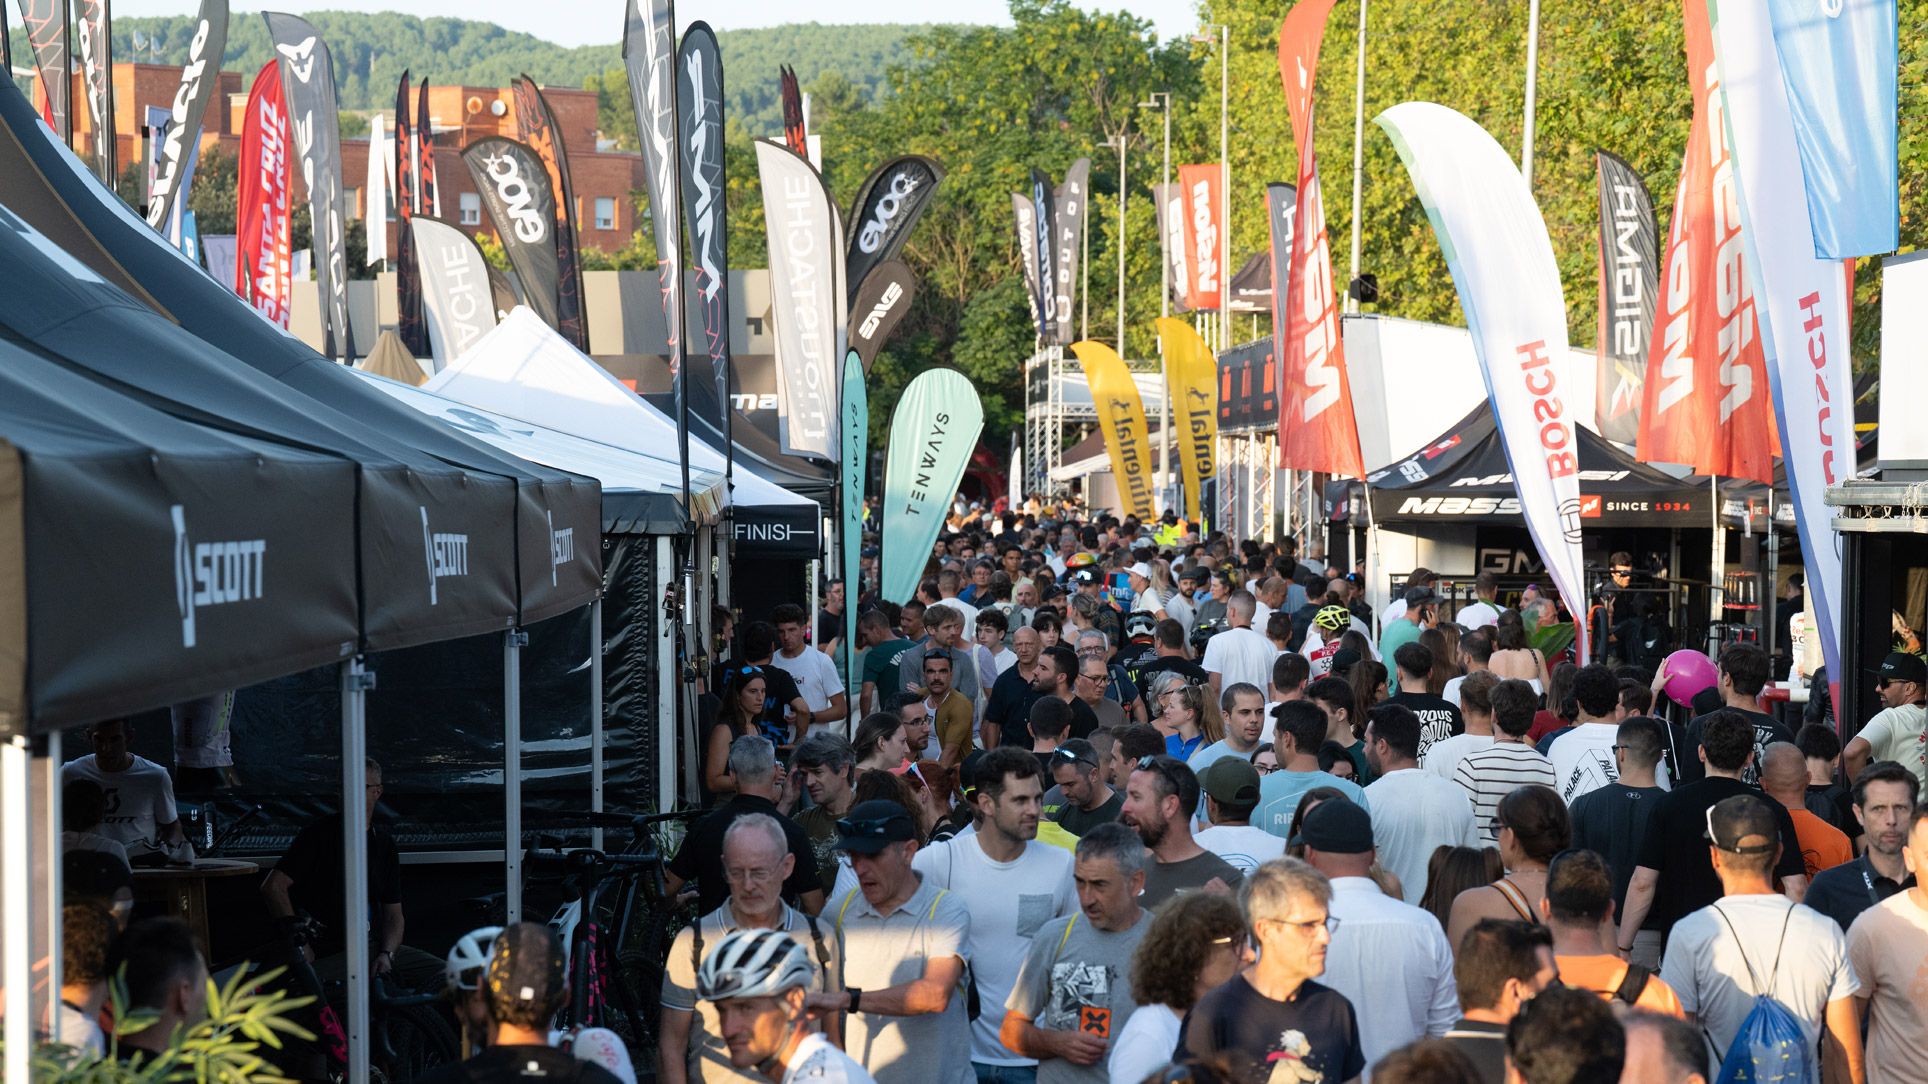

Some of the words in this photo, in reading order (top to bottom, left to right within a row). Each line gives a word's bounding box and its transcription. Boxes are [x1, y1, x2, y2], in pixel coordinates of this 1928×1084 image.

[859, 172, 913, 254] evoc
[905, 411, 950, 516] TENWAYS
[1606, 501, 1649, 512] SINCE
[1655, 502, 1690, 512] 1934
[432, 532, 469, 577] SCOTT
[553, 526, 575, 565] SCOTT
[194, 539, 266, 607] SCOTT
[1413, 710, 1453, 724] ROUS
[1564, 766, 1583, 802] PALACE
[1599, 759, 1618, 785] PALA
